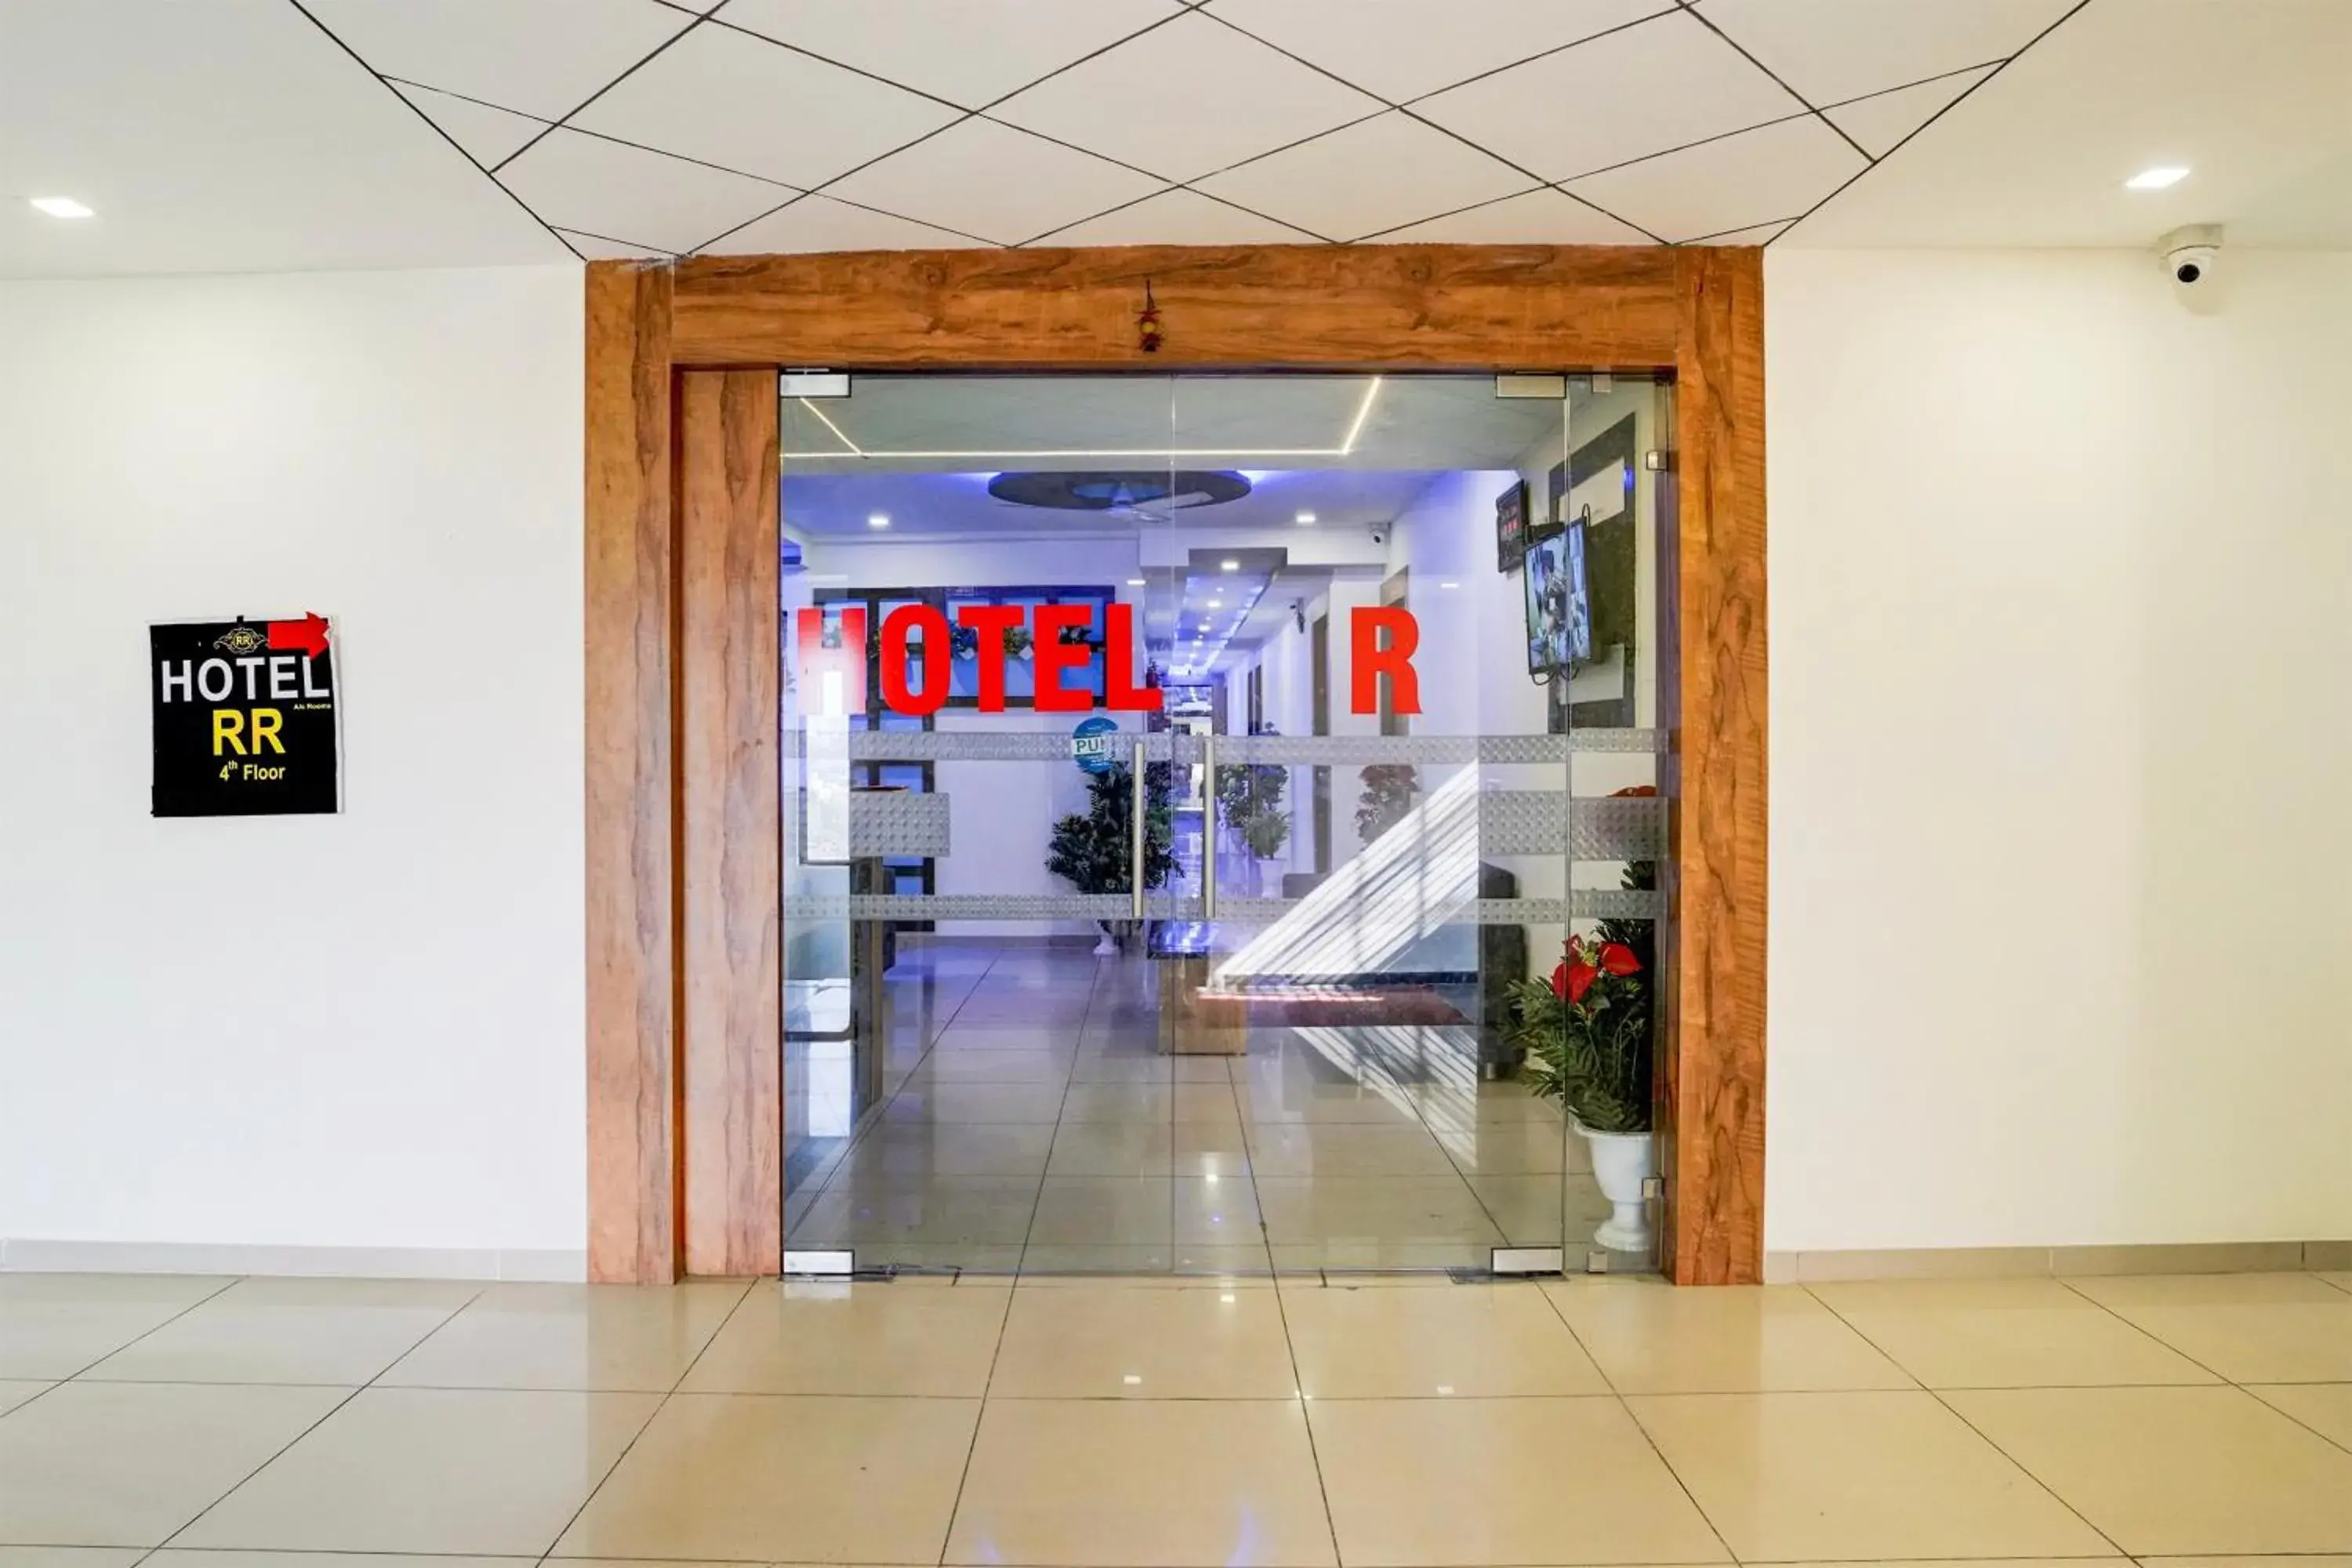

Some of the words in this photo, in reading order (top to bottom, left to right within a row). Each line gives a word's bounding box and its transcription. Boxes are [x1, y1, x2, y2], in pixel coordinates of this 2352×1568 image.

[236, 636, 251, 645] RR
[798, 603, 1163, 716] HOTEL
[1351, 606, 1421, 715] R
[162, 655, 330, 702] HOTEL
[212, 708, 285, 756] RR
[1076, 738, 1105, 753] PU
[219, 760, 238, 782] 4th
[243, 764, 286, 780] Floor
